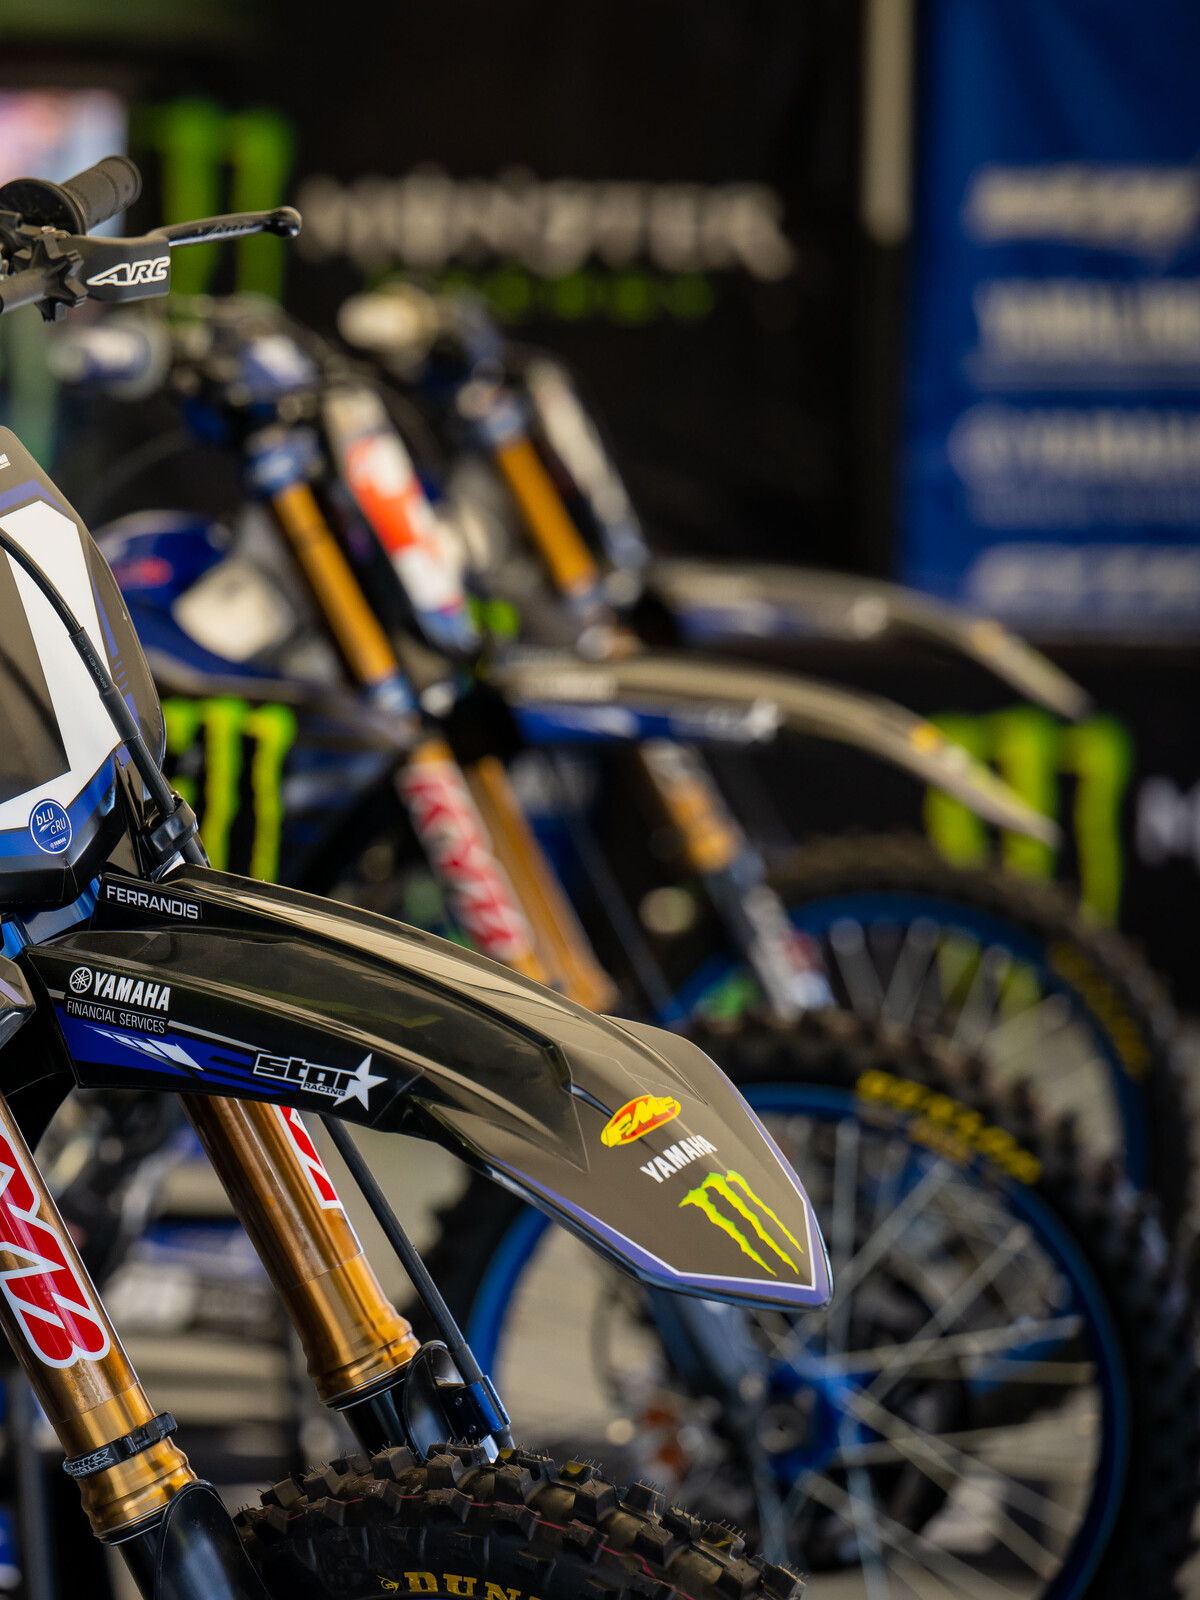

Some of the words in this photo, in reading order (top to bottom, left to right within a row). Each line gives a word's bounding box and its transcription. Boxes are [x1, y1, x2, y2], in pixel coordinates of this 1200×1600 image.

[86, 256, 171, 286] ARC
[106, 884, 199, 920] FERRANDIS
[93, 971, 171, 1011] YAMAHA
[66, 1000, 117, 1024] FINANCIAL
[119, 1012, 166, 1034] SERVICES
[302, 1082, 347, 1097] RACING
[604, 1096, 676, 1148] FMF
[640, 1134, 719, 1183] YAMAHA
[403, 1571, 544, 1600] DUN
